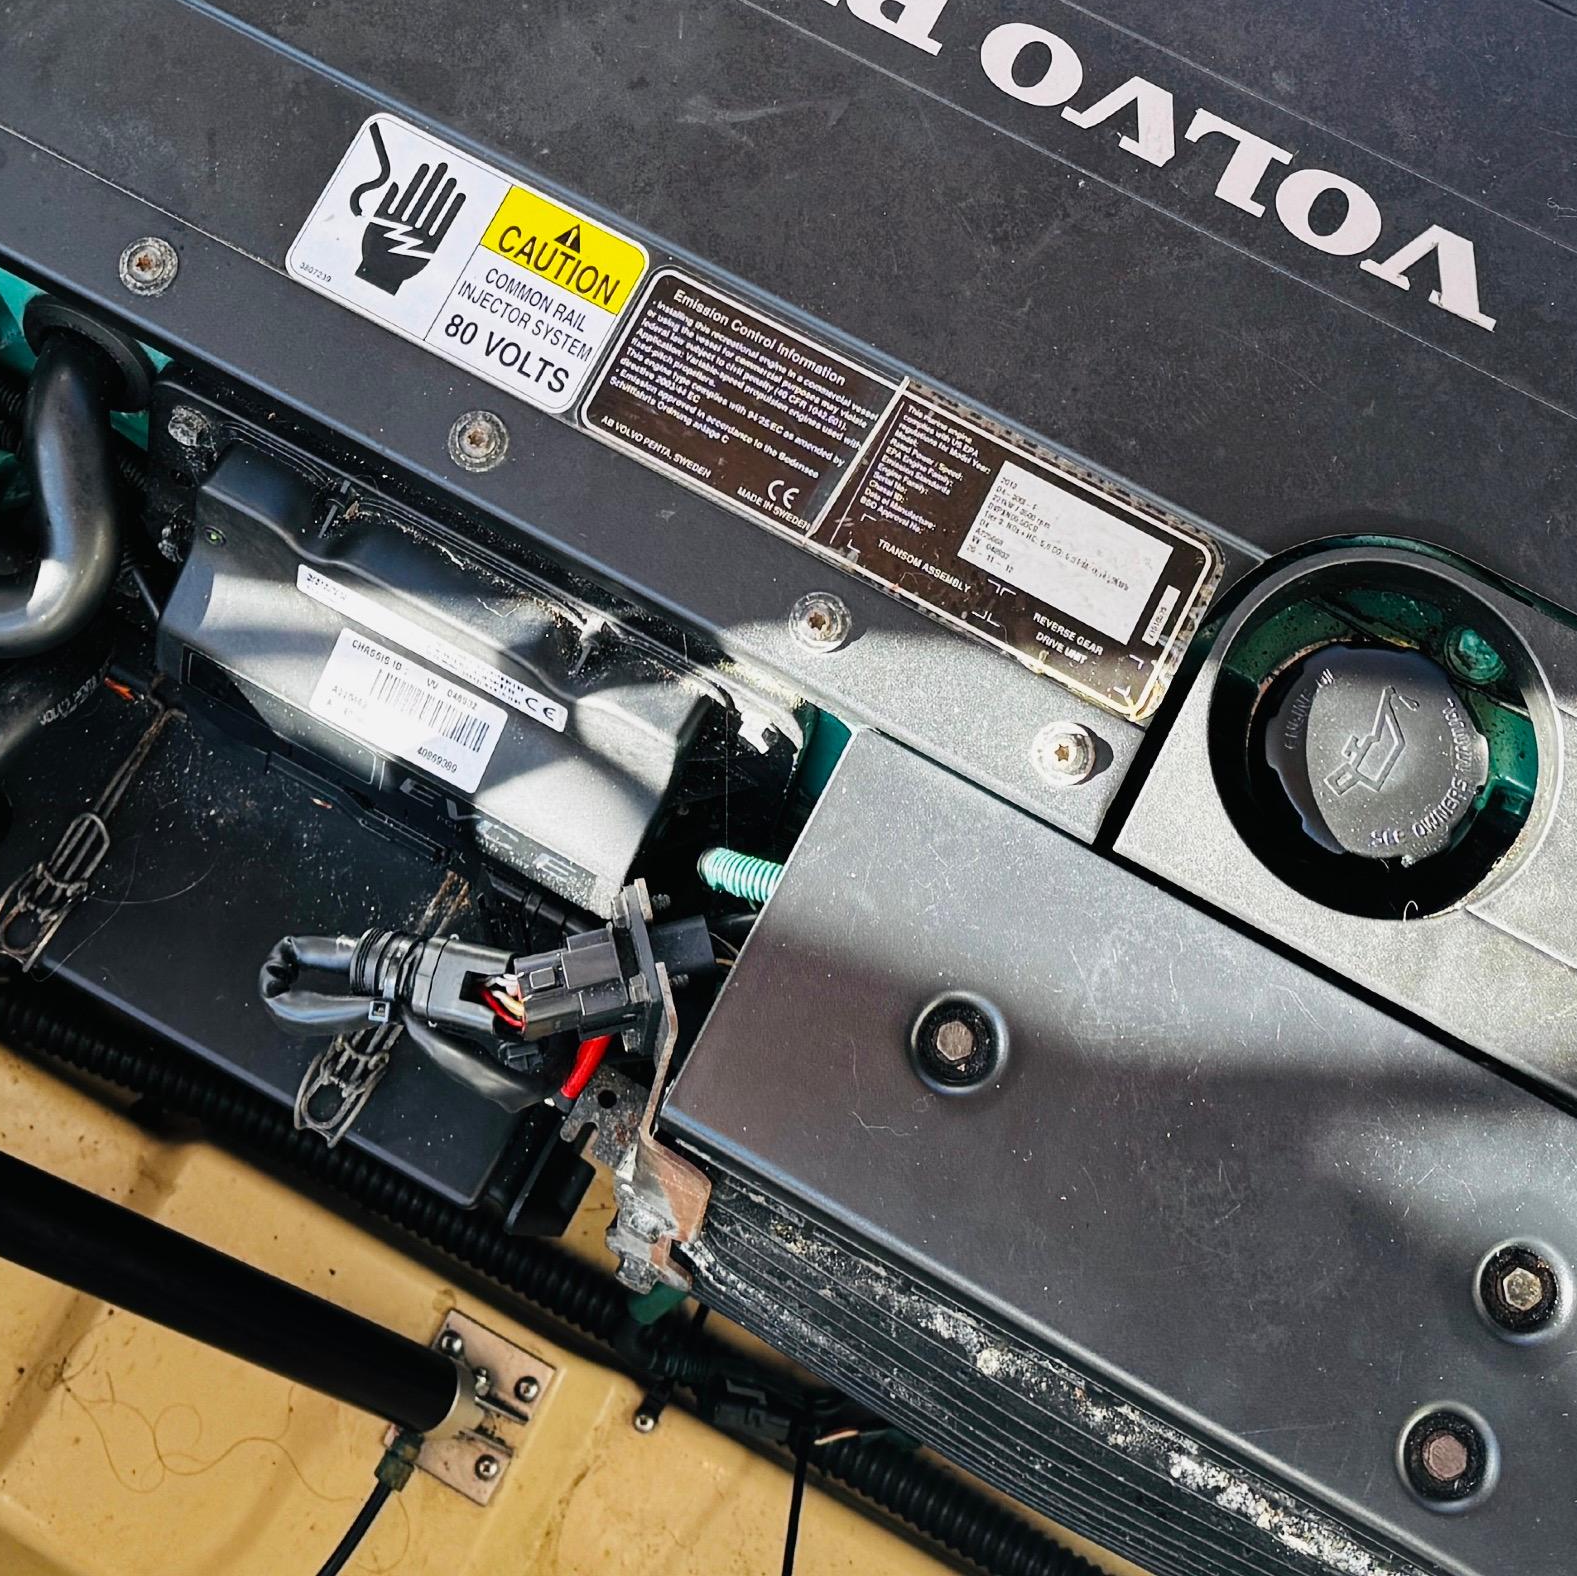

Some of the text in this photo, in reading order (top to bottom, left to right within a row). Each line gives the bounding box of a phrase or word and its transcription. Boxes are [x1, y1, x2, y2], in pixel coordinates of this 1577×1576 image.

[981, 20, 1498, 332] VOLVO
[494, 221, 621, 307] CAUTION
[456, 279, 594, 363] INJECTOR SYSTEM
[483, 266, 590, 333] COMMON RAIL
[442, 311, 572, 395] 80 VOLTS
[672, 287, 847, 388] Emission Control Information
[600, 413, 712, 479] AB VOLVO PENTA, SWEDEN
[735, 485, 811, 532] MADE IN SWEDEN
[876, 538, 971, 594] TRANSOM ASSEMBLY
[350, 638, 392, 665] CHASSIS
[1031, 611, 1104, 656] REVERSE GEAR
[1034, 631, 1088, 666] DRIVE UNIT
[1412, 776, 1468, 837] OWNERS
